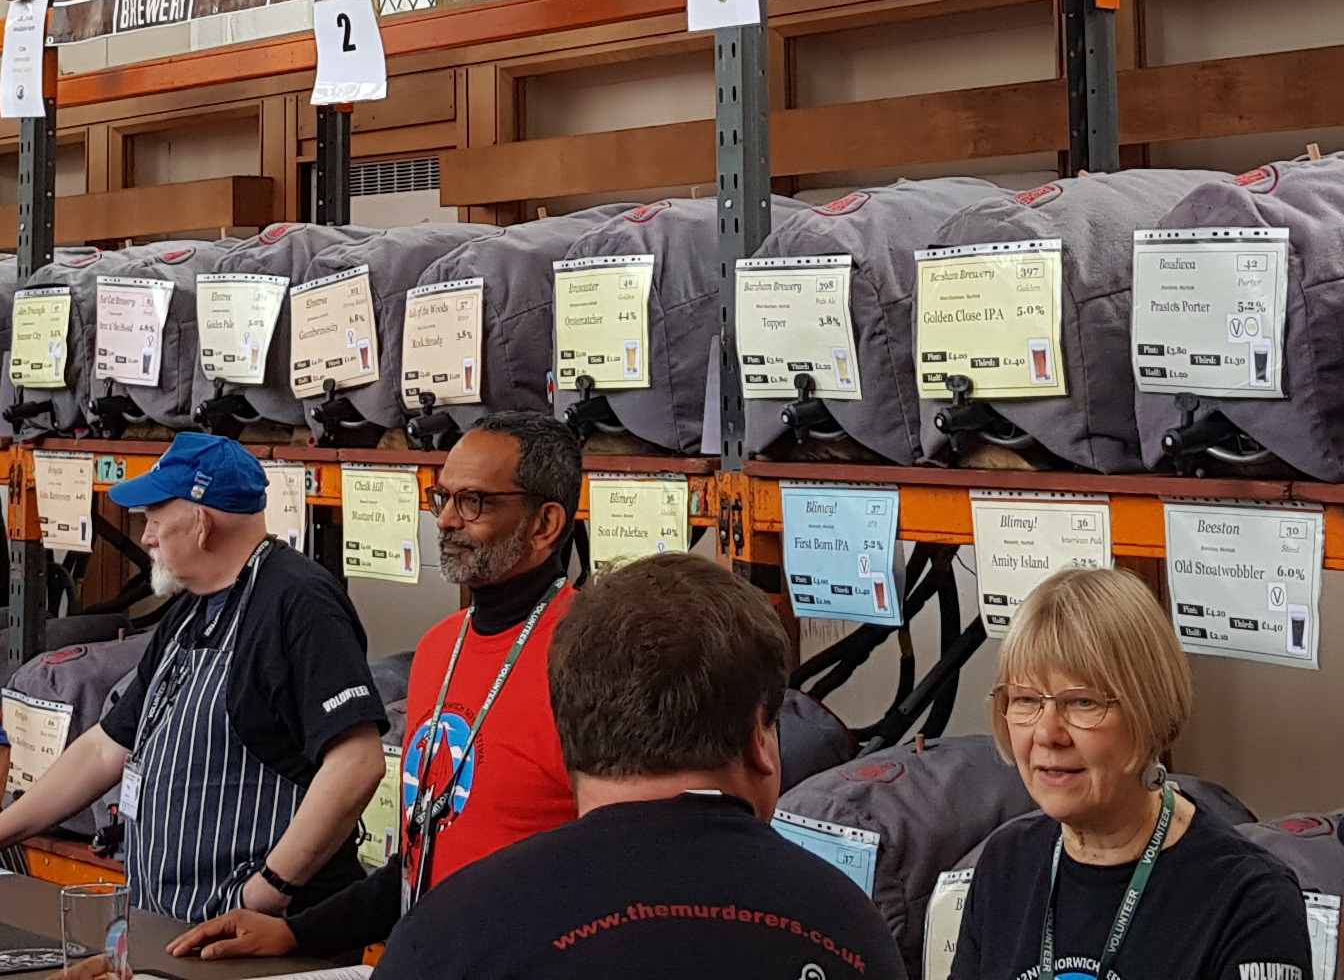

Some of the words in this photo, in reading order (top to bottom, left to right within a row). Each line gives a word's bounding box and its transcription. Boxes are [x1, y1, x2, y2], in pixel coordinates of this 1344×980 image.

[337, 13, 356, 52] 2
[1017, 306, 1045, 316] 5.0%
[1182, 301, 1211, 313] Porter
[762, 318, 786, 329] Topper
[924, 309, 953, 324] Golden
[984, 308, 1004, 320] IPA
[806, 501, 838, 516] Blimey!
[1000, 515, 1038, 532] Blimey!
[1077, 519, 1088, 529] 36
[1197, 519, 1240, 535] Beeston
[1286, 526, 1299, 536] 30
[795, 537, 812, 548] First
[835, 539, 849, 551] IPA
[992, 554, 1019, 570] Amity
[1021, 555, 1049, 569] Island
[1175, 560, 1193, 574] Old
[1195, 562, 1265, 579] Stoatwobbler
[1277, 565, 1305, 580] 6.0%
[1107, 889, 1140, 954] VOLUNTEER
[553, 902, 867, 975] www.themurderers.co.uk
